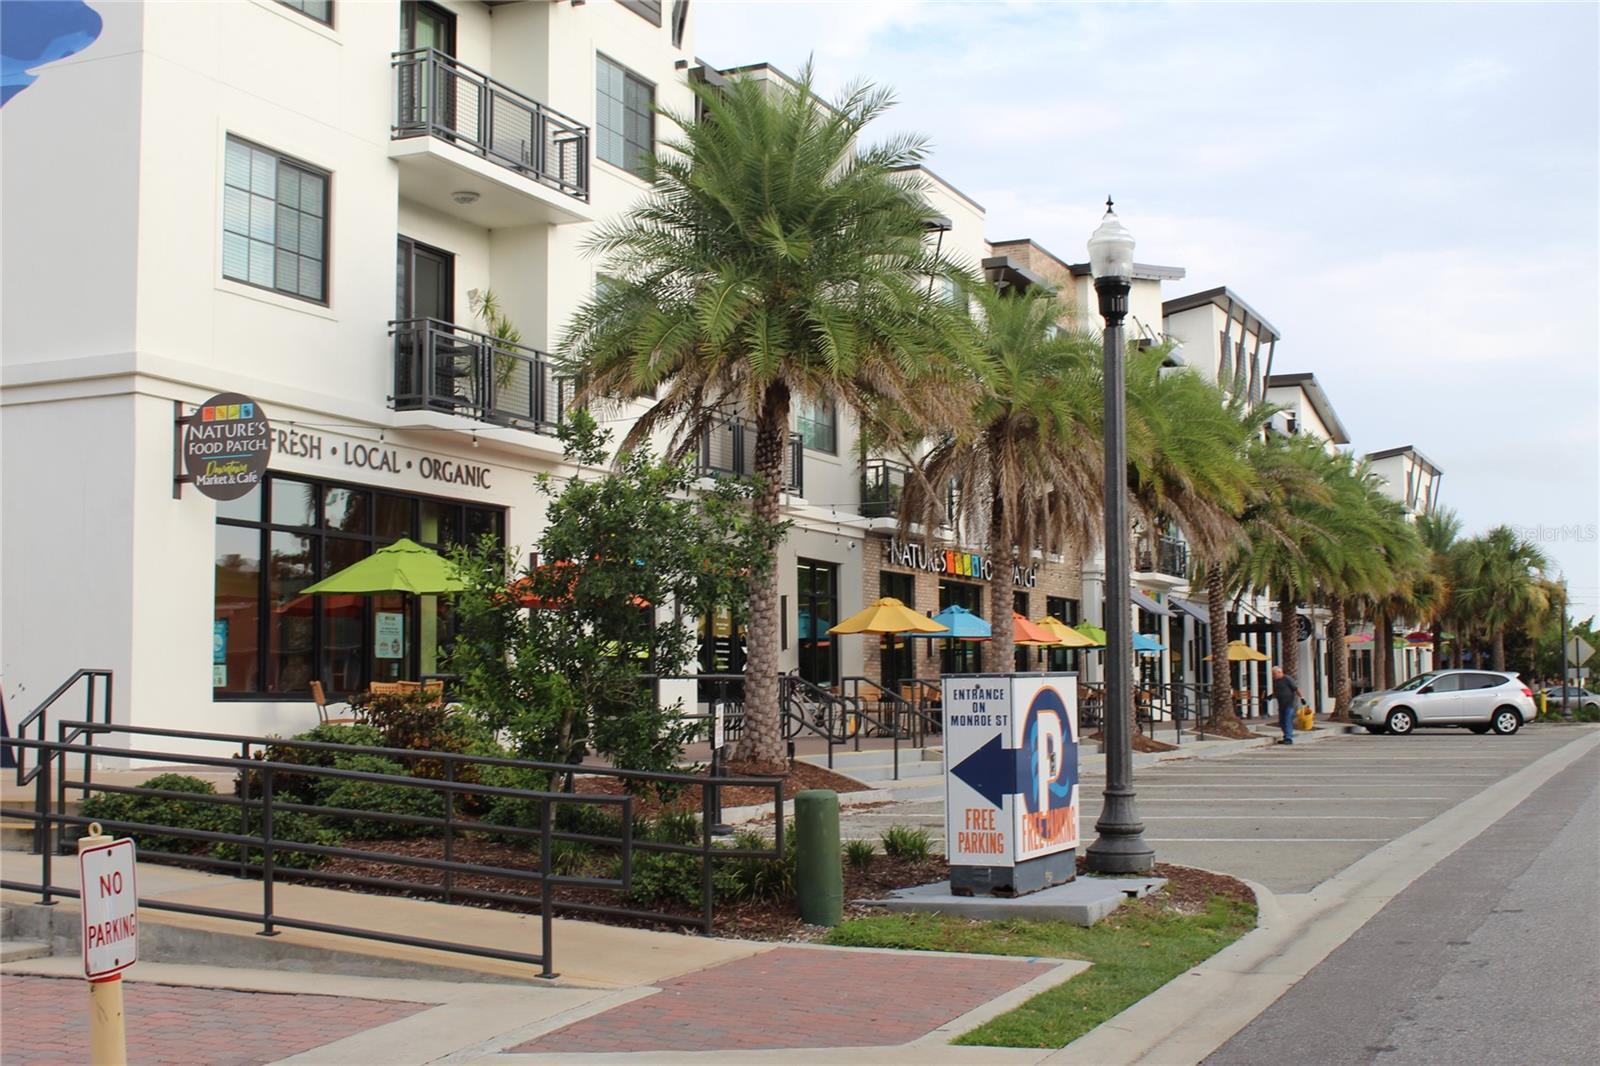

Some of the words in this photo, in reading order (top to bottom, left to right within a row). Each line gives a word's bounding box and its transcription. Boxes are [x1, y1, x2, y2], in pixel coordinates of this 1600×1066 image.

[189, 422, 266, 440] NATURE'S
[189, 442, 223, 455] FOOD
[226, 439, 268, 453] PATCH
[344, 441, 401, 473] LOCAL
[419, 457, 491, 489] ORGANIC
[196, 475, 227, 485] Market
[953, 688, 1004, 700] ENTRANCE
[972, 702, 986, 713] ON
[951, 714, 992, 727] MONROE
[995, 714, 1008, 727] ST
[965, 808, 996, 831] FREE
[958, 831, 1004, 854] PARKING
[99, 871, 123, 898] NO
[88, 913, 136, 950] PARKING
